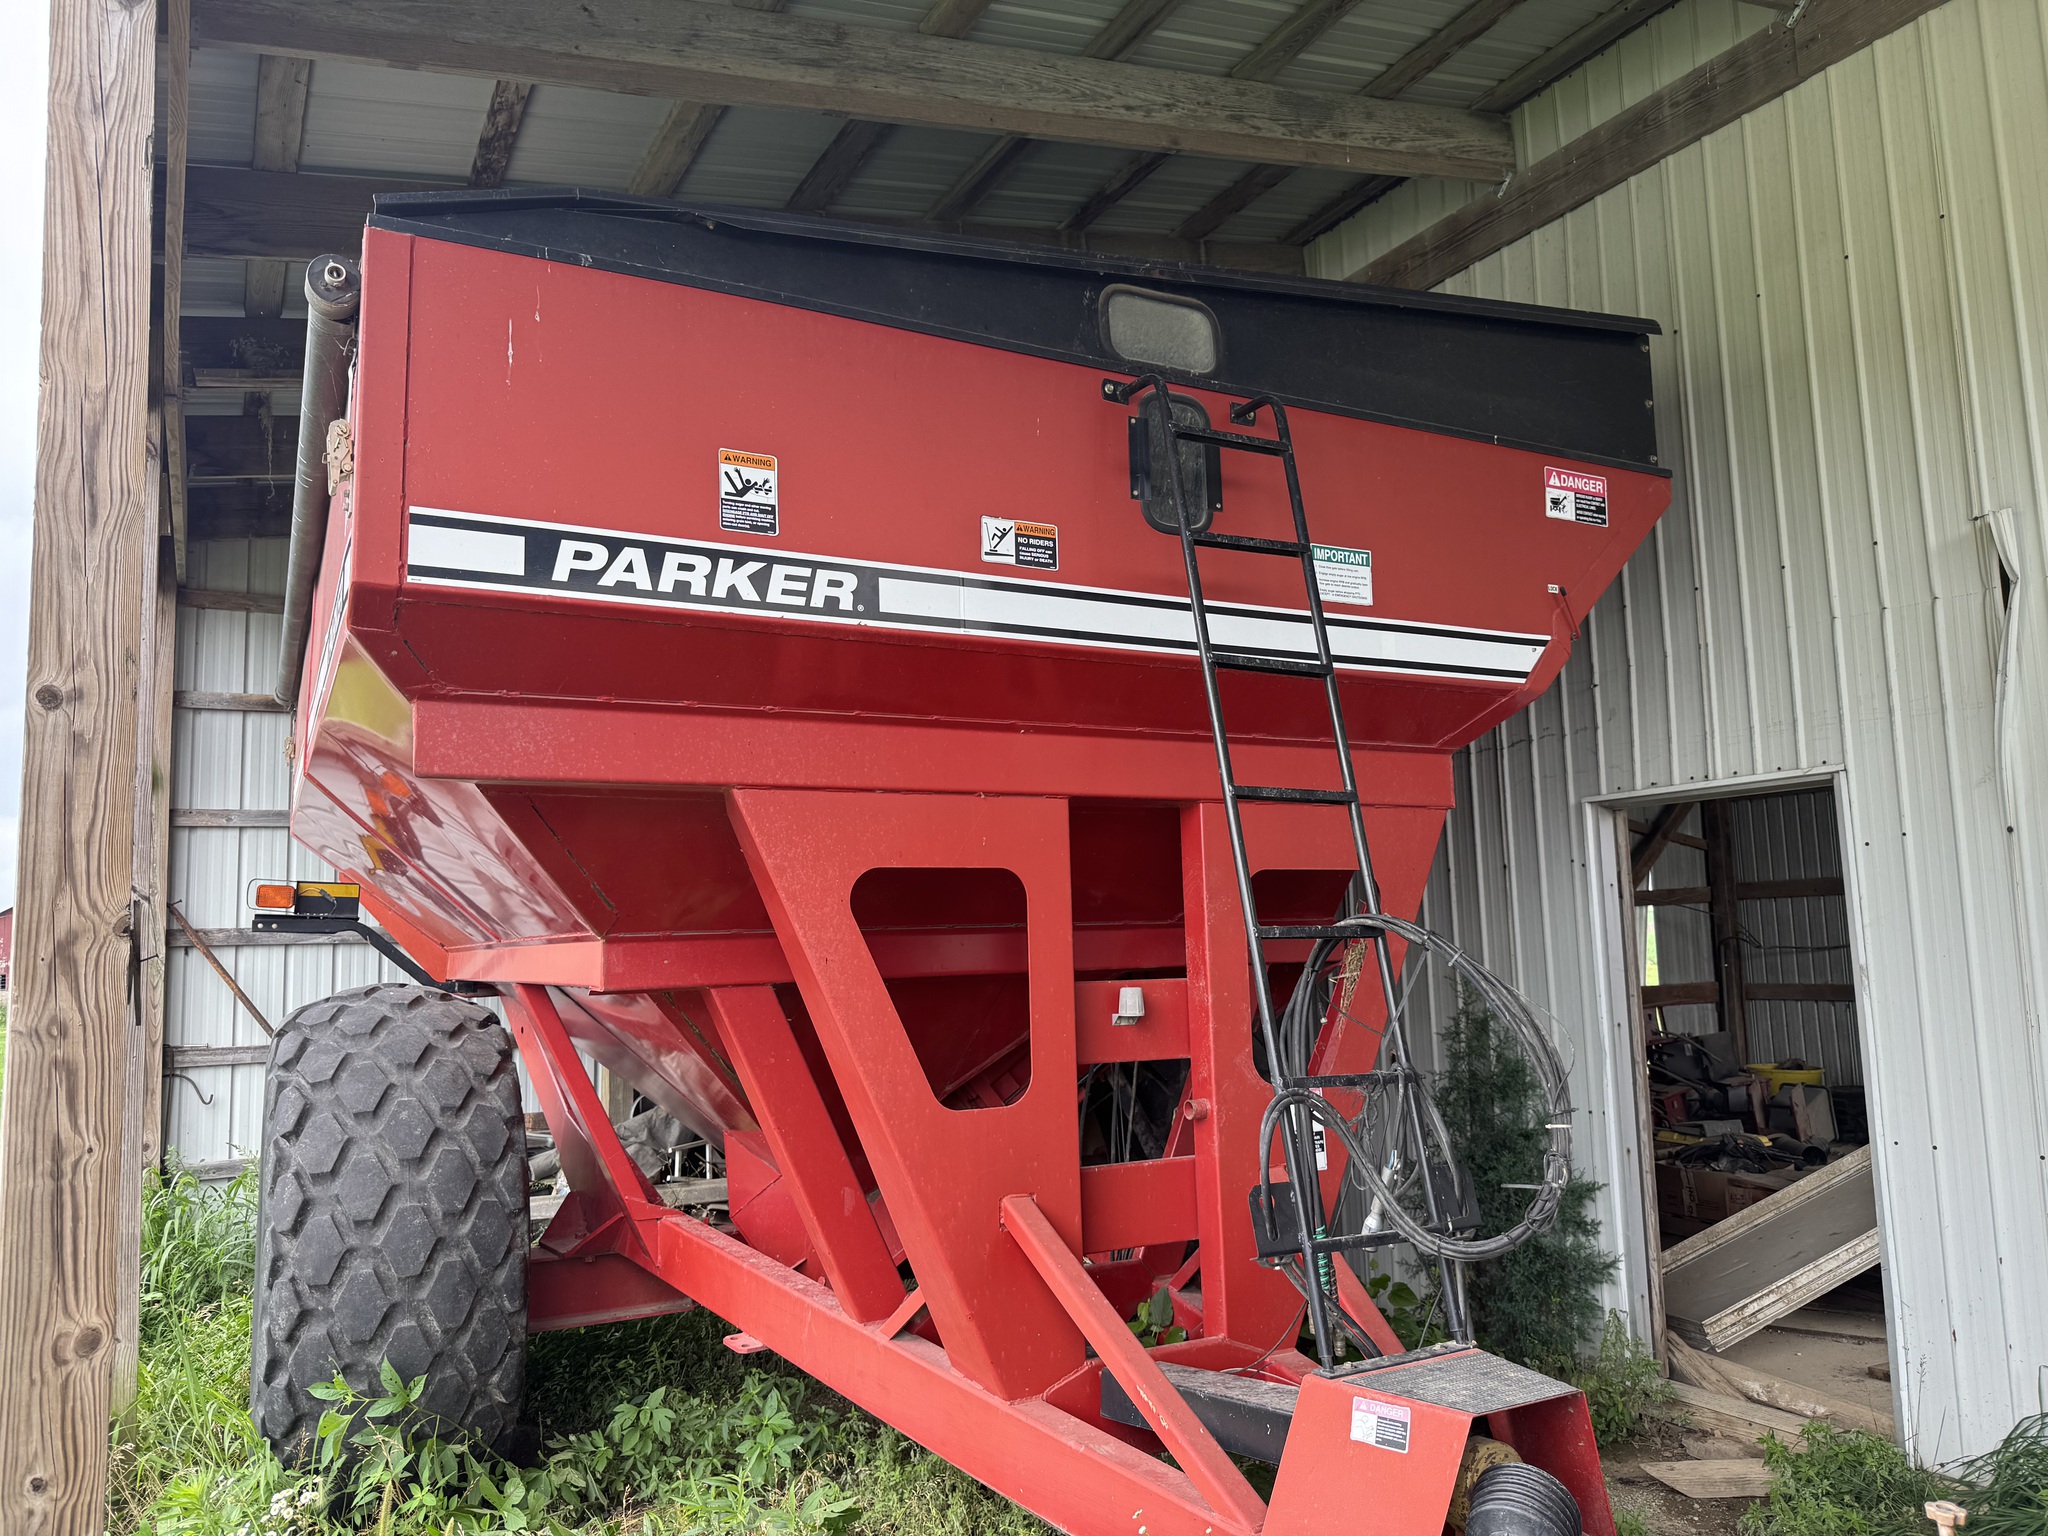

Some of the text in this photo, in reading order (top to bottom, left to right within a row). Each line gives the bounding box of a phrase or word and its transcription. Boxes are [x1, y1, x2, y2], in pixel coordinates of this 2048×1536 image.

[732, 454, 772, 467] WARNING
[1560, 474, 1603, 494] DANGER
[1023, 525, 1055, 536] WARNING
[1017, 536, 1054, 547] NO RIDERS
[1313, 547, 1368, 565] IMPORTANT
[551, 539, 859, 611] PARKER
[1370, 1403, 1404, 1418] DANGER
